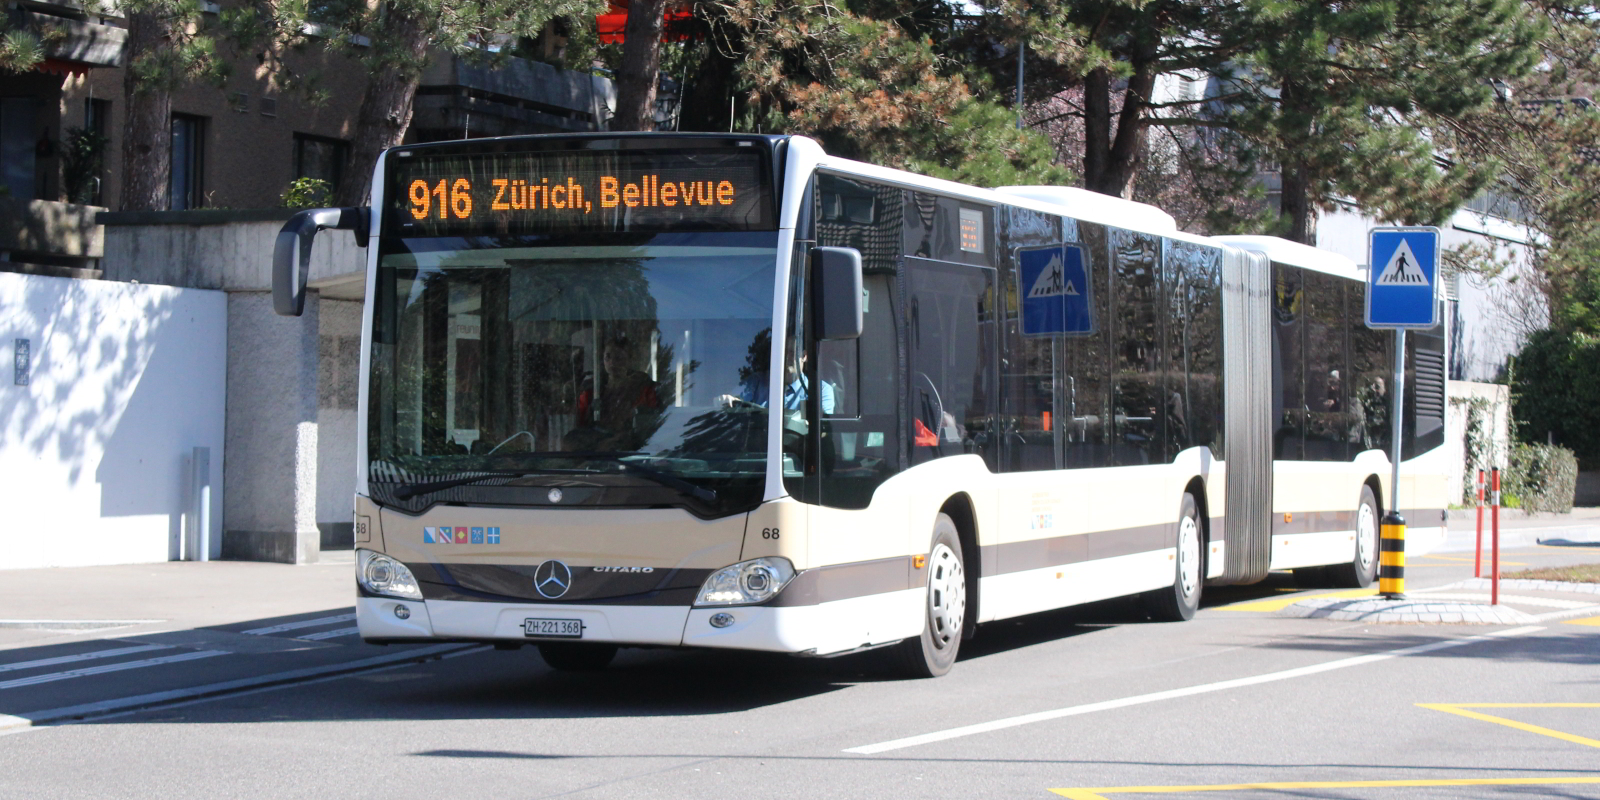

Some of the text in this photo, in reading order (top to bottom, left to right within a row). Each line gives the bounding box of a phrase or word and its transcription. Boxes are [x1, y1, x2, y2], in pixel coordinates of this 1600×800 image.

[408, 175, 734, 220] 916 Zürich, Bellevue
[762, 527, 780, 540] 68
[593, 566, 654, 574] CITARO
